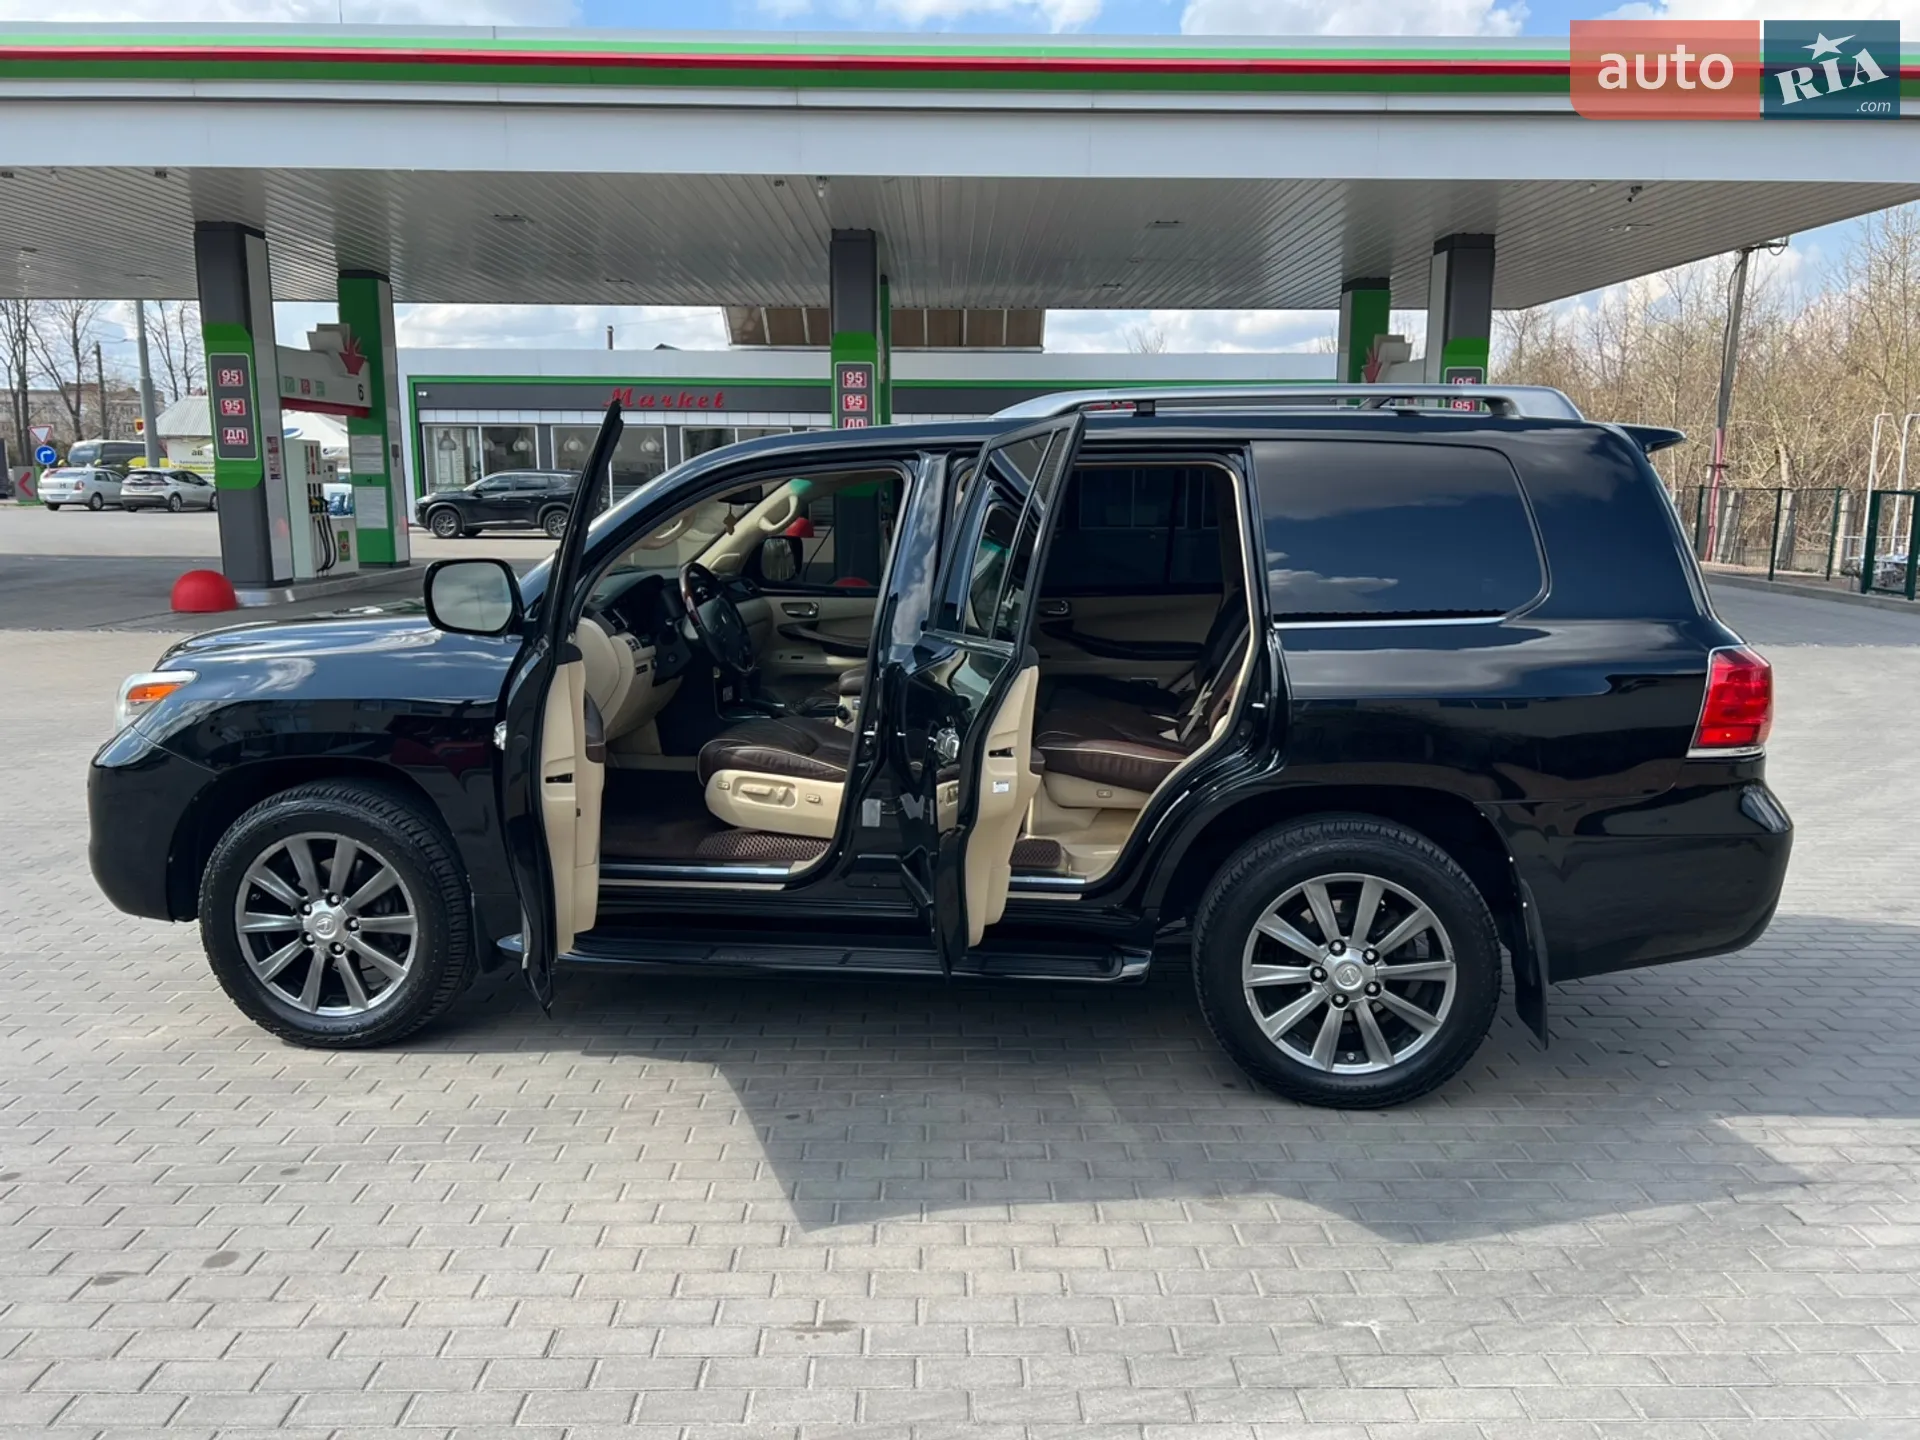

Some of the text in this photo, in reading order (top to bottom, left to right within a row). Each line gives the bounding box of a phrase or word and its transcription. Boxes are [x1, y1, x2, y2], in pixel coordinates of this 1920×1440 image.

[222, 369, 239, 382] 95
[846, 371, 863, 384] 95
[357, 383, 364, 401] 6
[602, 387, 725, 408] Market
[224, 400, 241, 411] 95
[847, 394, 863, 406] 95
[226, 429, 245, 440] ДП
